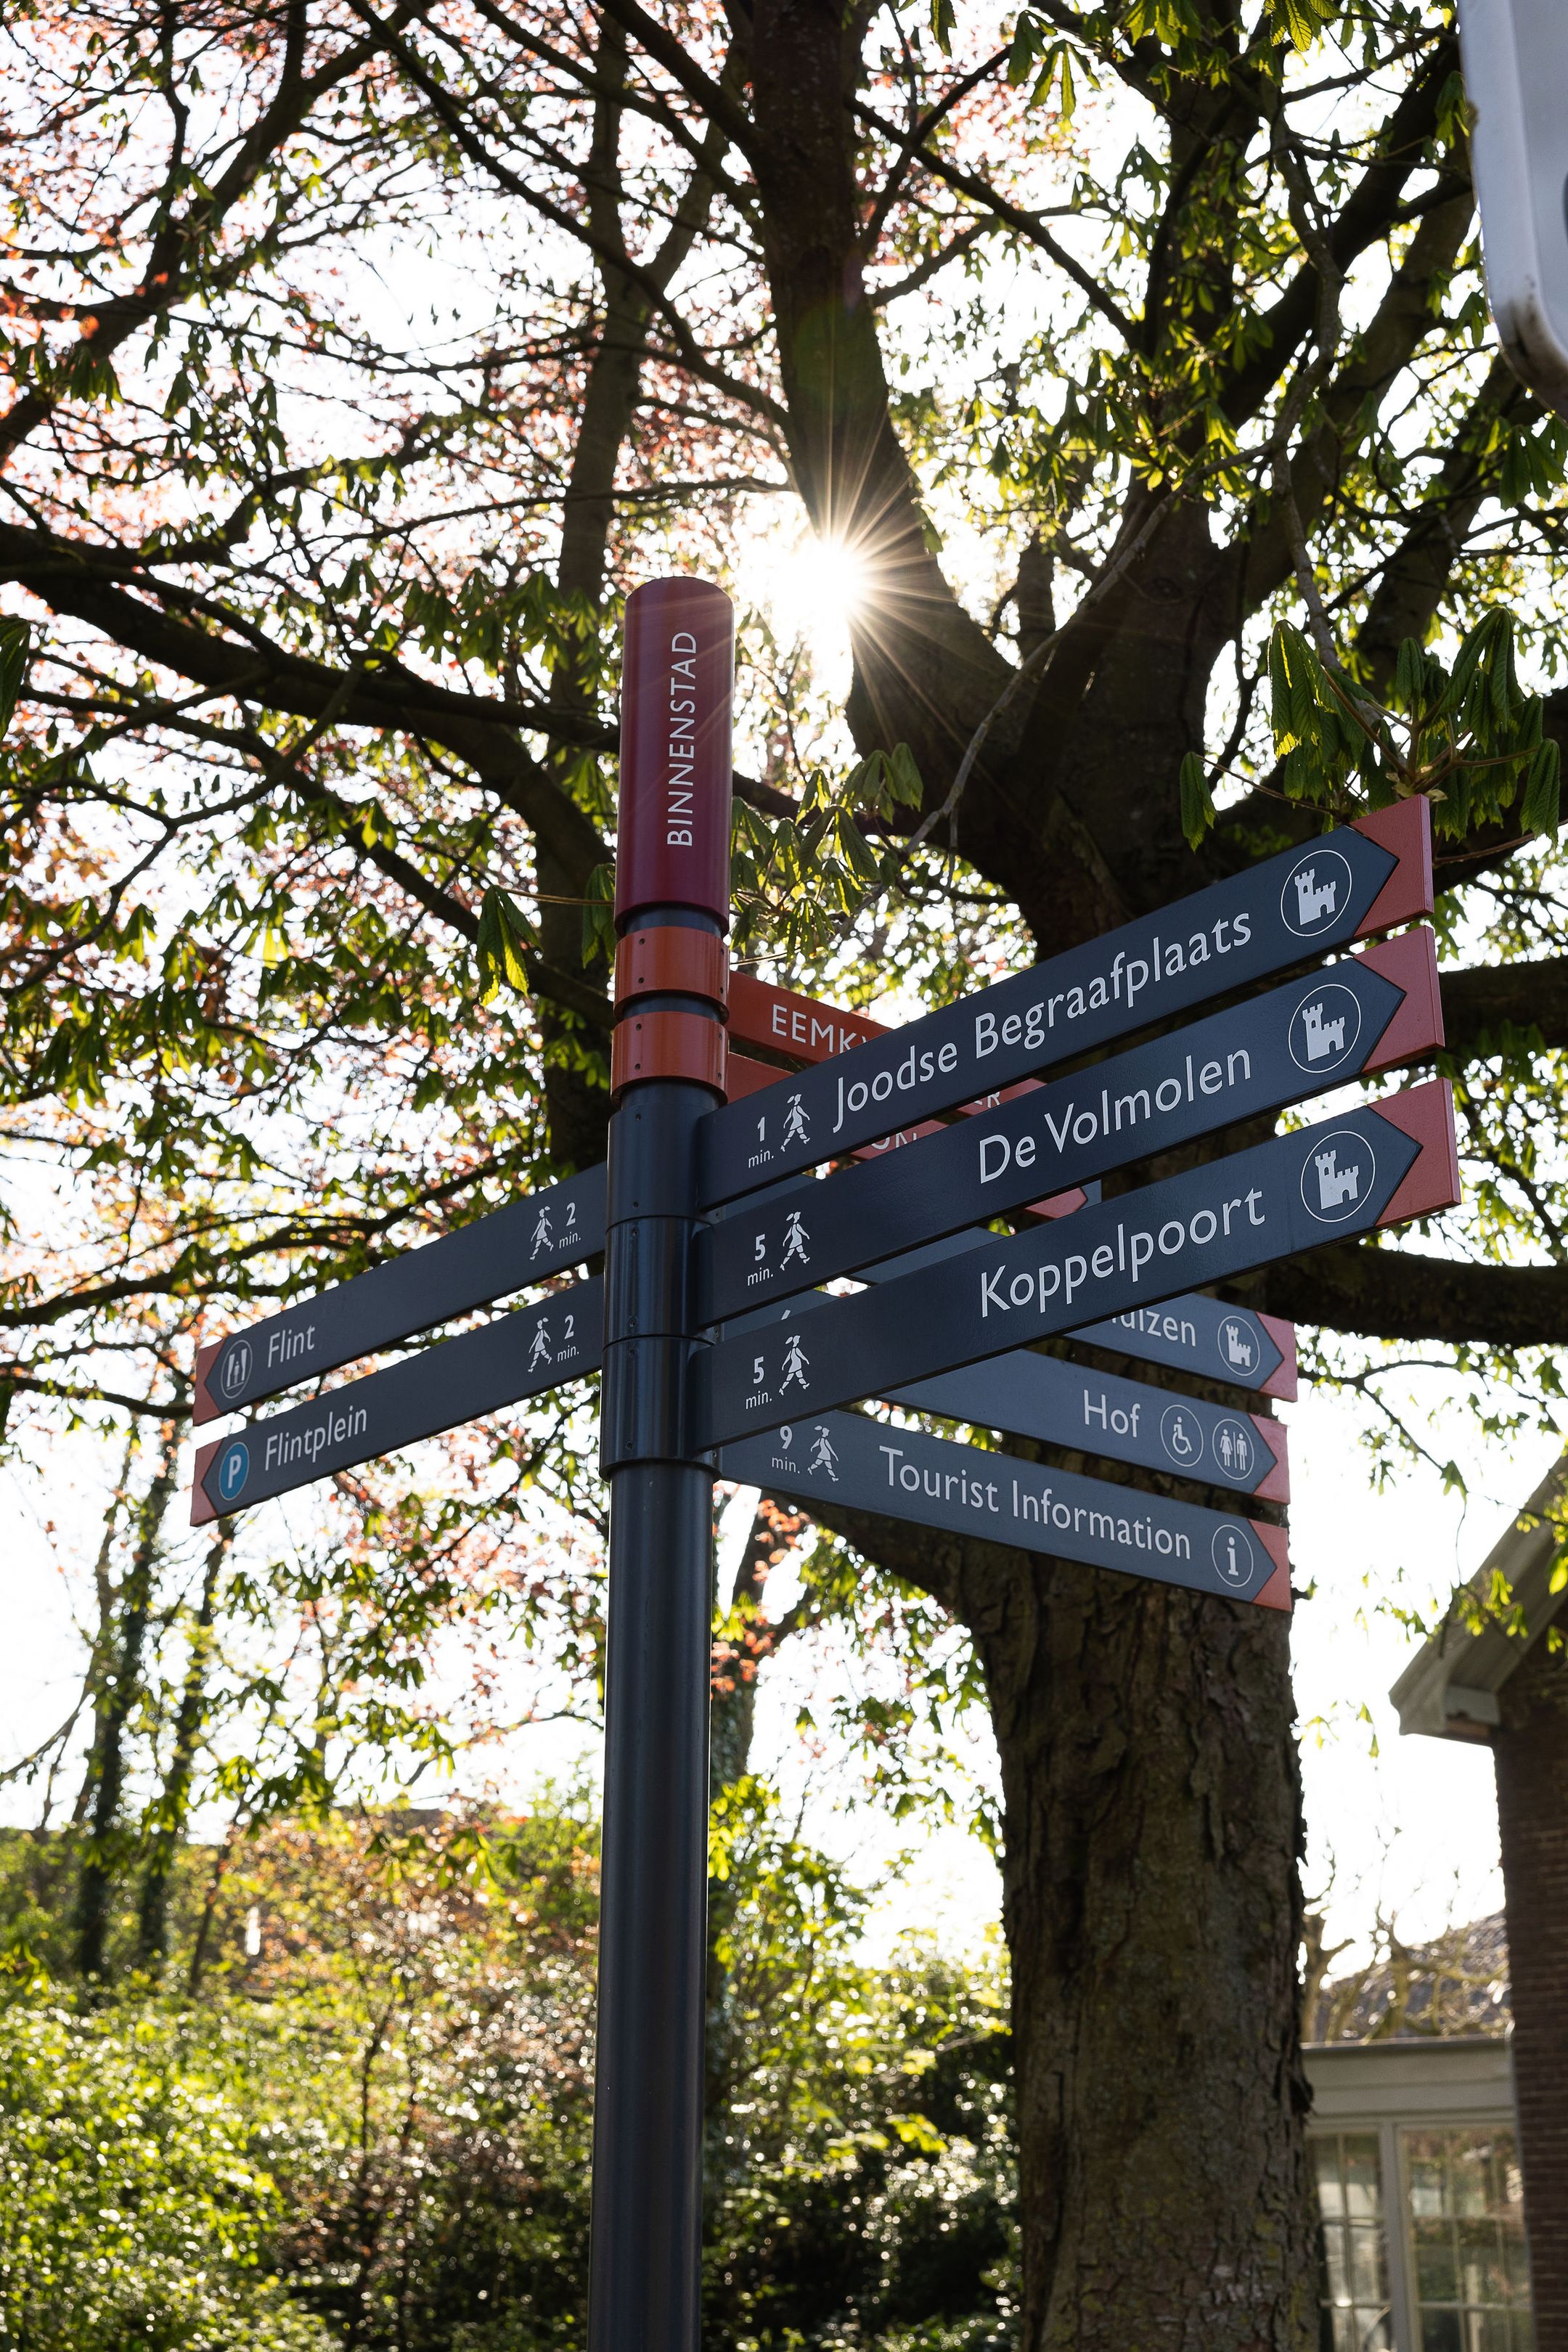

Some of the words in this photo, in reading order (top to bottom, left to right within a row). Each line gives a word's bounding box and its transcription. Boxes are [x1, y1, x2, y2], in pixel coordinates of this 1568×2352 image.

[667, 632, 696, 846] BINNENSTAD
[772, 1004, 867, 1053] EEMK
[833, 1043, 957, 1132] Joodse
[976, 913, 1251, 1058] Begraafplaats
[756, 1116, 765, 1142] 1
[979, 1134, 1036, 1184] De
[1045, 1050, 1250, 1153] Volmolen
[748, 1148, 775, 1169] min.
[566, 1201, 576, 1226] 2
[559, 1232, 581, 1249] min.
[754, 1234, 766, 1261] 5
[981, 1188, 1265, 1318] Koppelpoort
[747, 1266, 774, 1286] min.
[565, 1314, 574, 1339] 2
[1112, 1309, 1196, 1347] uizen
[268, 1325, 315, 1368] Flint
[557, 1345, 579, 1363] min.
[753, 1356, 764, 1384] 5
[746, 1389, 772, 1410] min.
[1085, 1389, 1140, 1437] Hof
[266, 1405, 367, 1471] Flintplein
[780, 1426, 792, 1449] 9
[228, 1454, 242, 1490] P
[772, 1455, 800, 1474] min.
[880, 1446, 998, 1511] Tourist
[1013, 1480, 1190, 1559] Information
